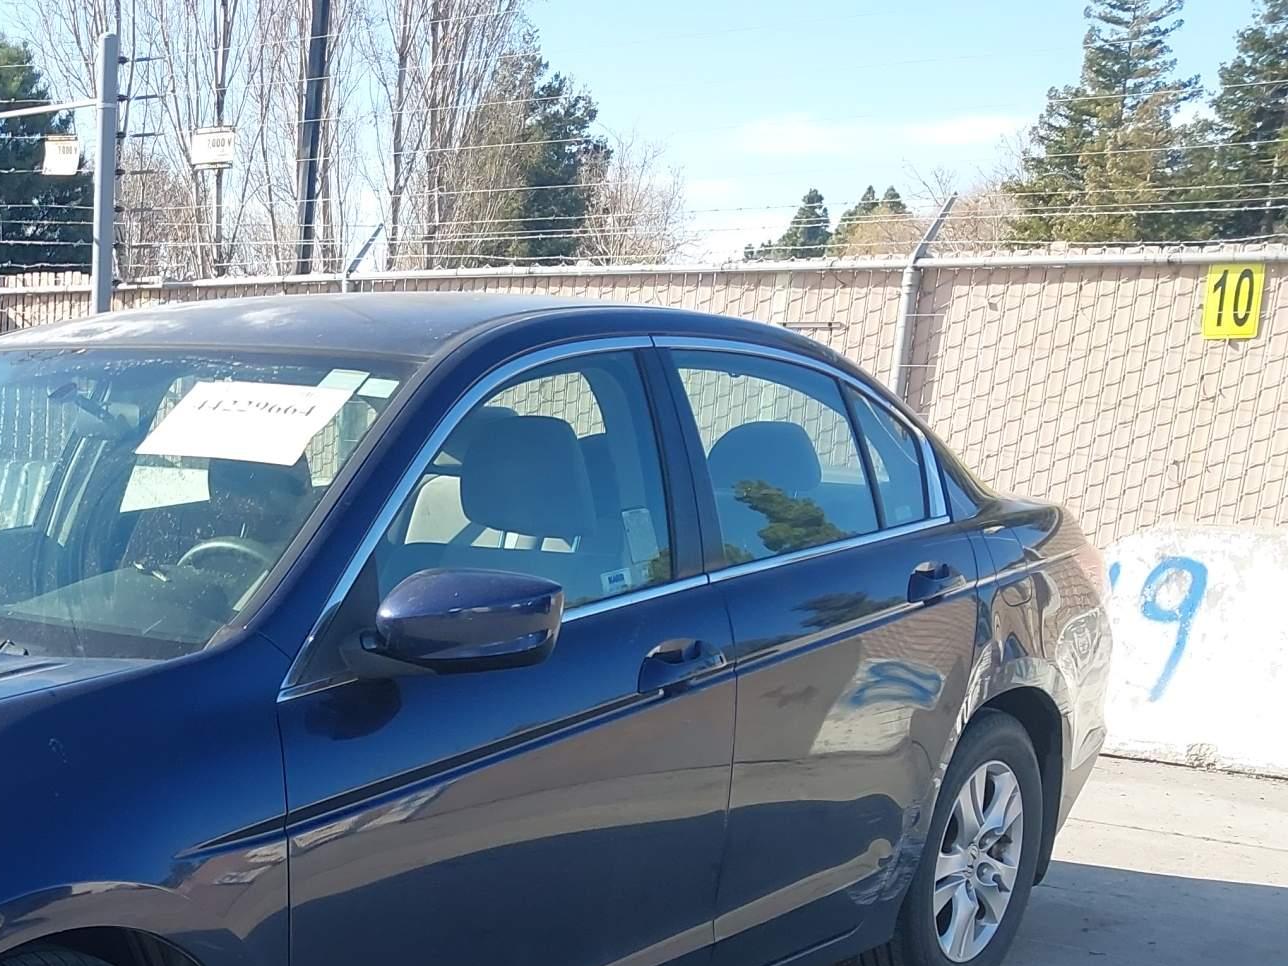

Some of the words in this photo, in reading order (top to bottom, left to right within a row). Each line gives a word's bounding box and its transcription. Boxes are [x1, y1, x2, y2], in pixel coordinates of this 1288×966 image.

[227, 137, 232, 147] V
[1212, 267, 1255, 327] 10
[193, 399, 317, 417] 44229664
